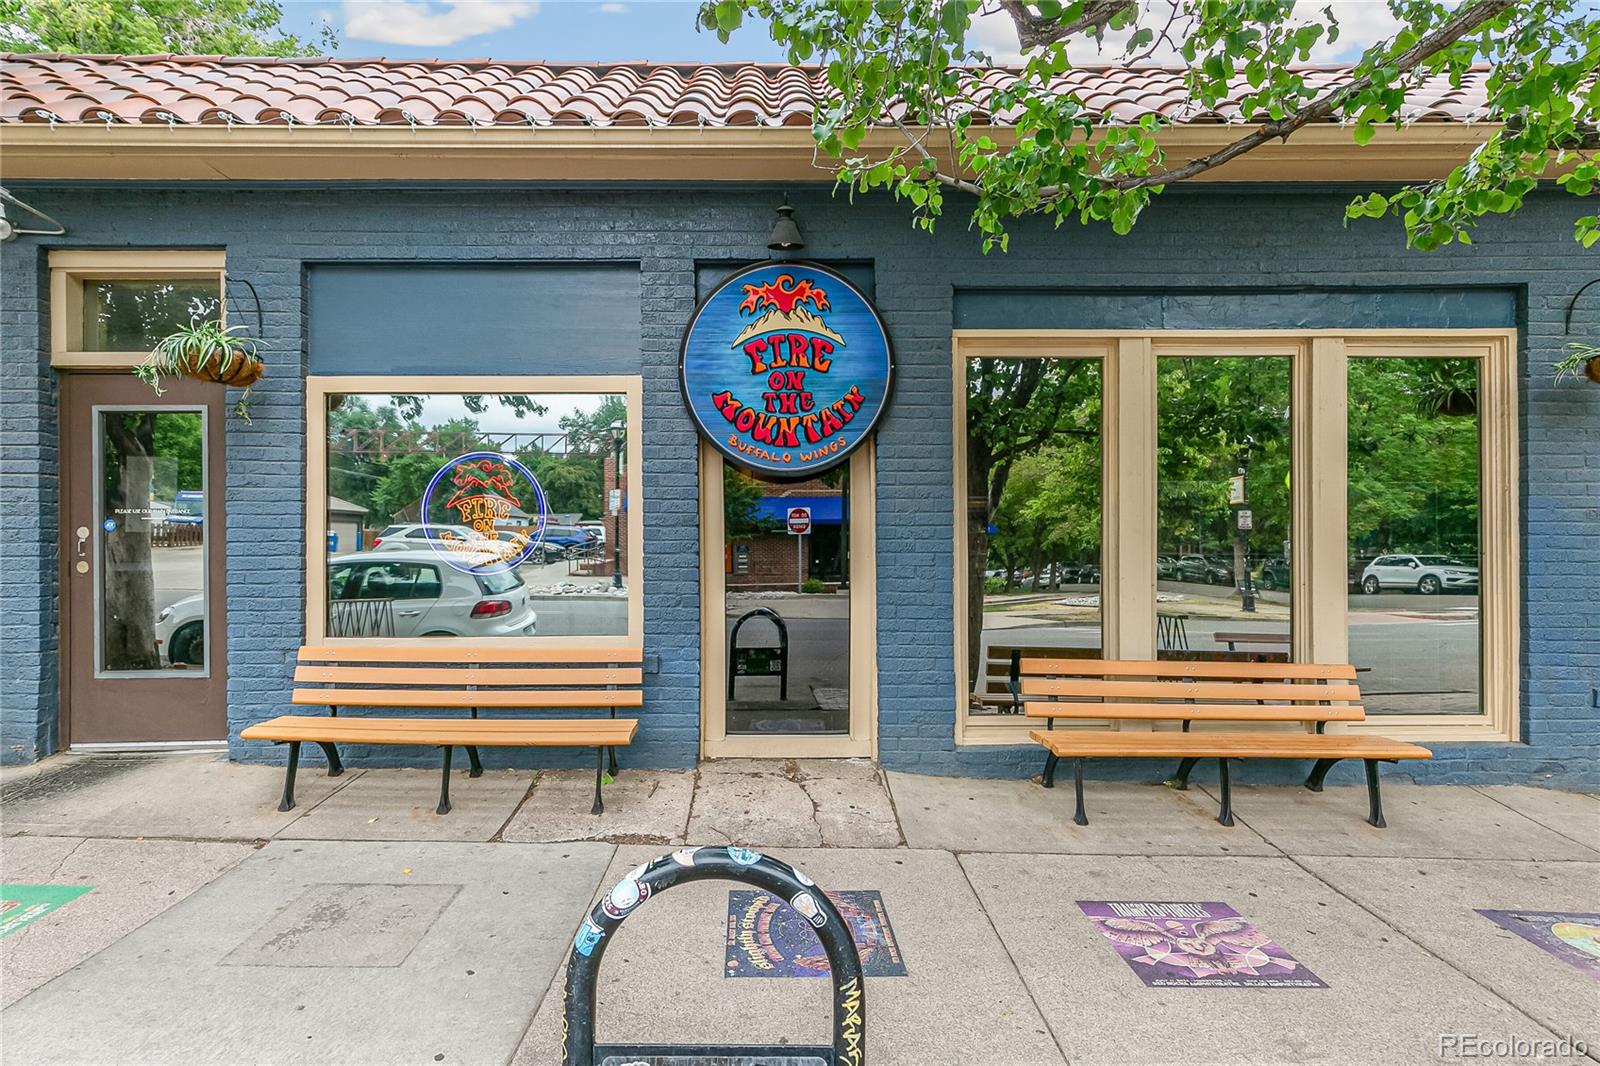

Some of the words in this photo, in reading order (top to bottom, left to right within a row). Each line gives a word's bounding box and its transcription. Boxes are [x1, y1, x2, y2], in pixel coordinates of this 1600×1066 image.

[743, 333, 835, 375] FIRE
[767, 371, 805, 391] ON
[712, 385, 866, 447] MOUNTAIN
[761, 392, 815, 414] THE
[727, 434, 792, 463] BUFFALO
[800, 437, 847, 462] WINGS
[456, 497, 512, 523] FIRE
[473, 519, 496, 532] ON
